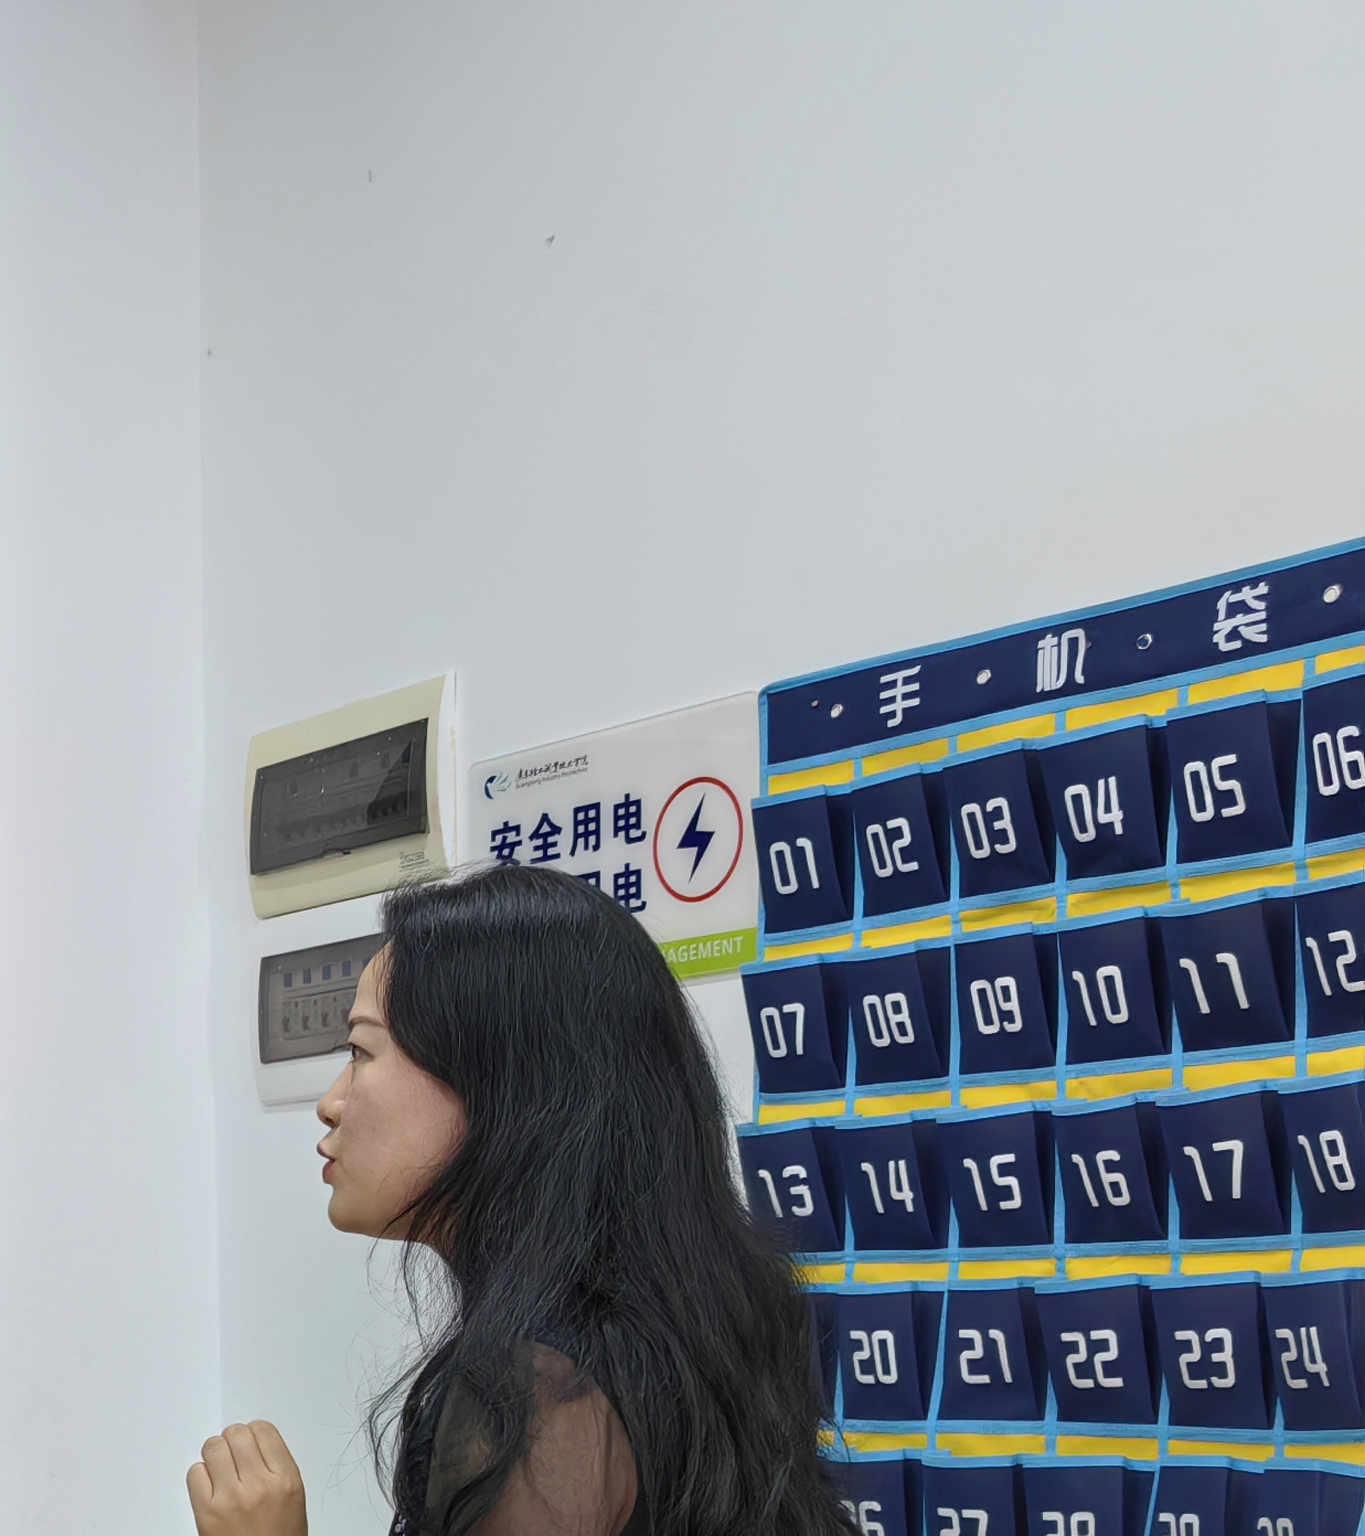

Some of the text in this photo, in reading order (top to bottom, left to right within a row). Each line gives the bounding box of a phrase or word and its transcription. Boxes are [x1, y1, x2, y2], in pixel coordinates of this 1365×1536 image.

[490, 792, 647, 866] 安全用电
[770, 726, 1365, 894] 01 02 03 04 05 06
[760, 930, 1365, 1057] 07 08 09 10 11 12
[758, 1130, 1355, 1217] 13 14 15 16 17 18
[850, 1326, 1329, 1388] 20 21 22 23 24
